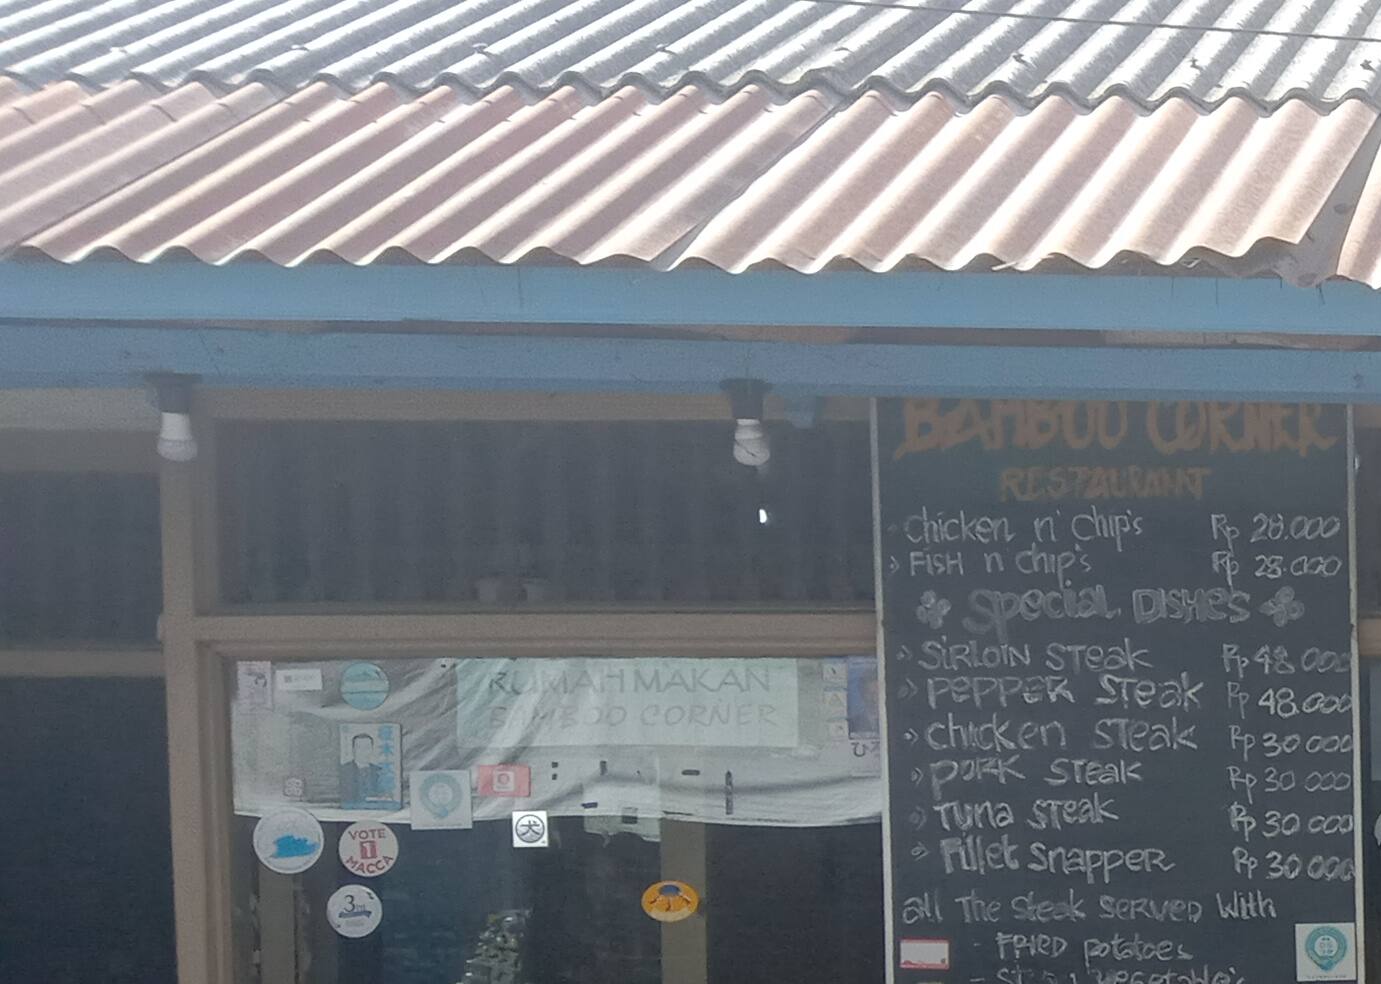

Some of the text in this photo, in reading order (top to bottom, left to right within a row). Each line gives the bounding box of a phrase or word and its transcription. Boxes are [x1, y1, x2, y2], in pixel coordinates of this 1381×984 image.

[893, 399, 1343, 460] BAMBOO CORNER
[1210, 513, 1239, 552] Rp
[1222, 643, 1250, 679] Rp
[633, 667, 769, 693] MAKAN
[641, 704, 778, 732] CORNER
[1227, 680, 1250, 720] Rp
[1228, 725, 1256, 765] Rp
[1229, 765, 1258, 804] Rp
[348, 829, 387, 841] VOTE
[1229, 802, 1257, 842] Rp
[345, 854, 394, 875] MACCA
[1232, 846, 1261, 881] Rp
